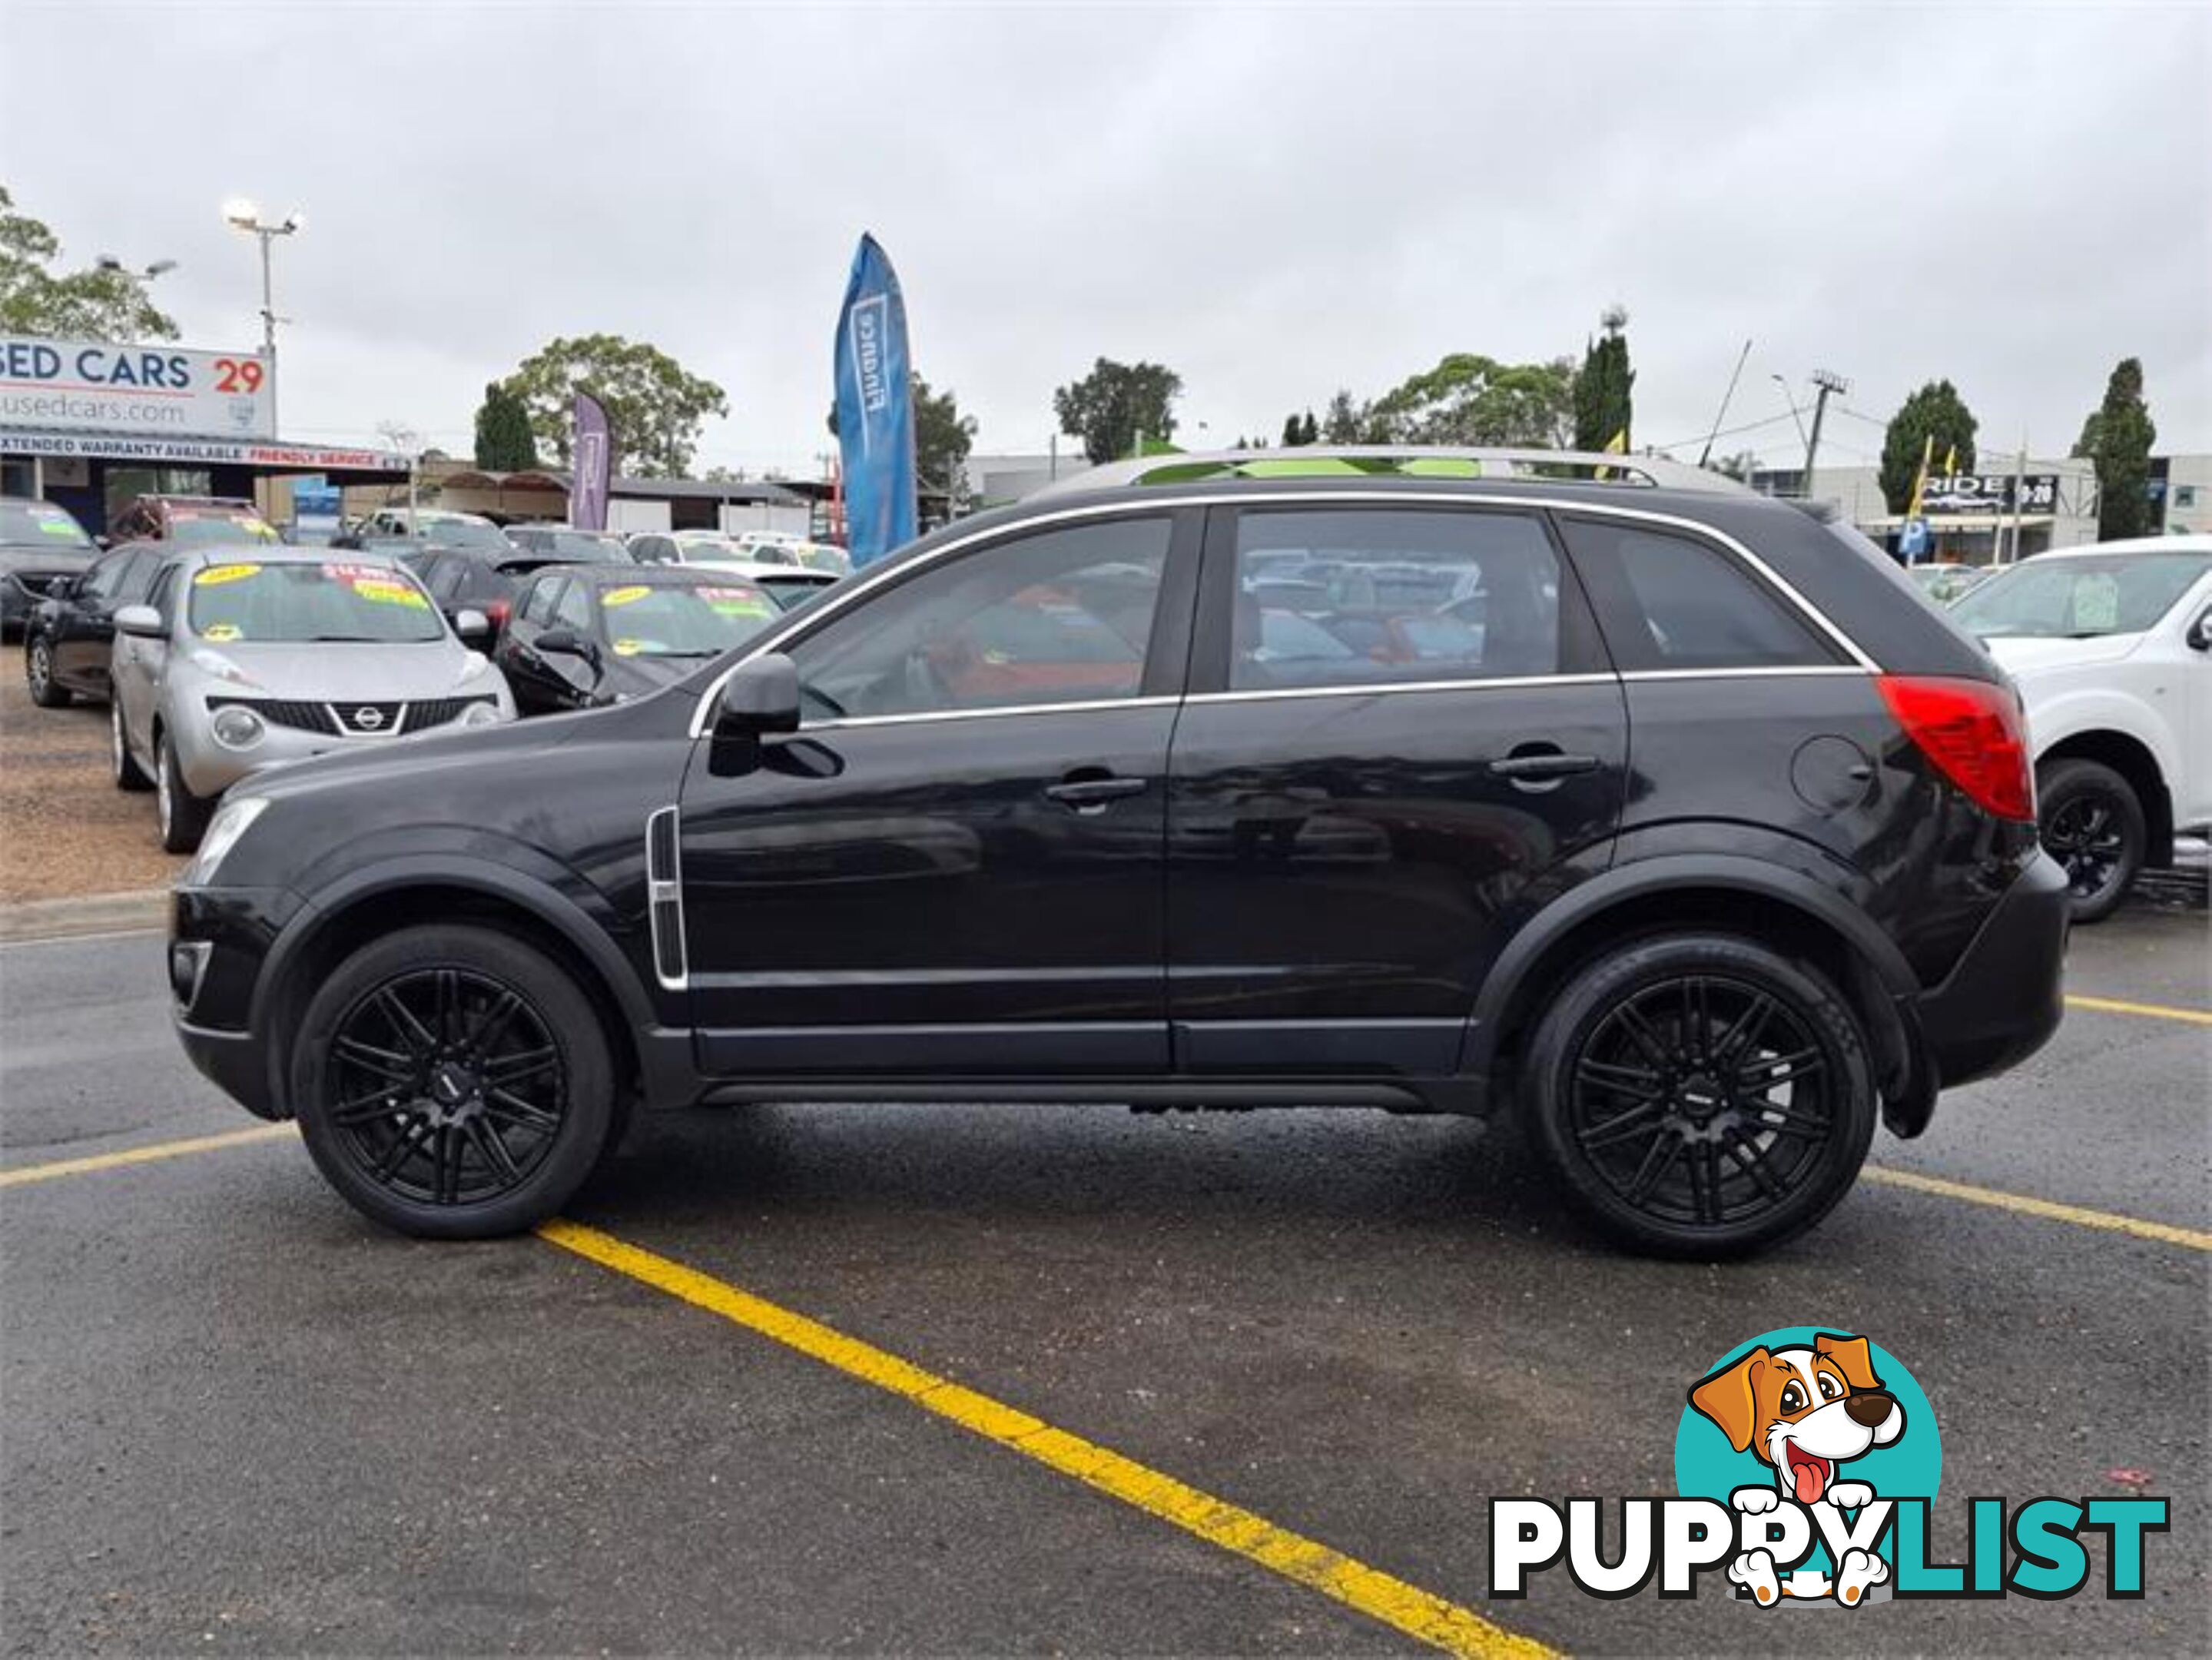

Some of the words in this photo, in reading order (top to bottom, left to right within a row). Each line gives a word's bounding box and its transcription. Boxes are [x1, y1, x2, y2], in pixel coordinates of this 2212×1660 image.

[77, 349, 191, 389] CARS
[214, 359, 264, 395] 29
[81, 440, 162, 456] WARRANTY
[164, 443, 240, 460] AVAILABLE
[250, 447, 314, 463] FRIENDLY
